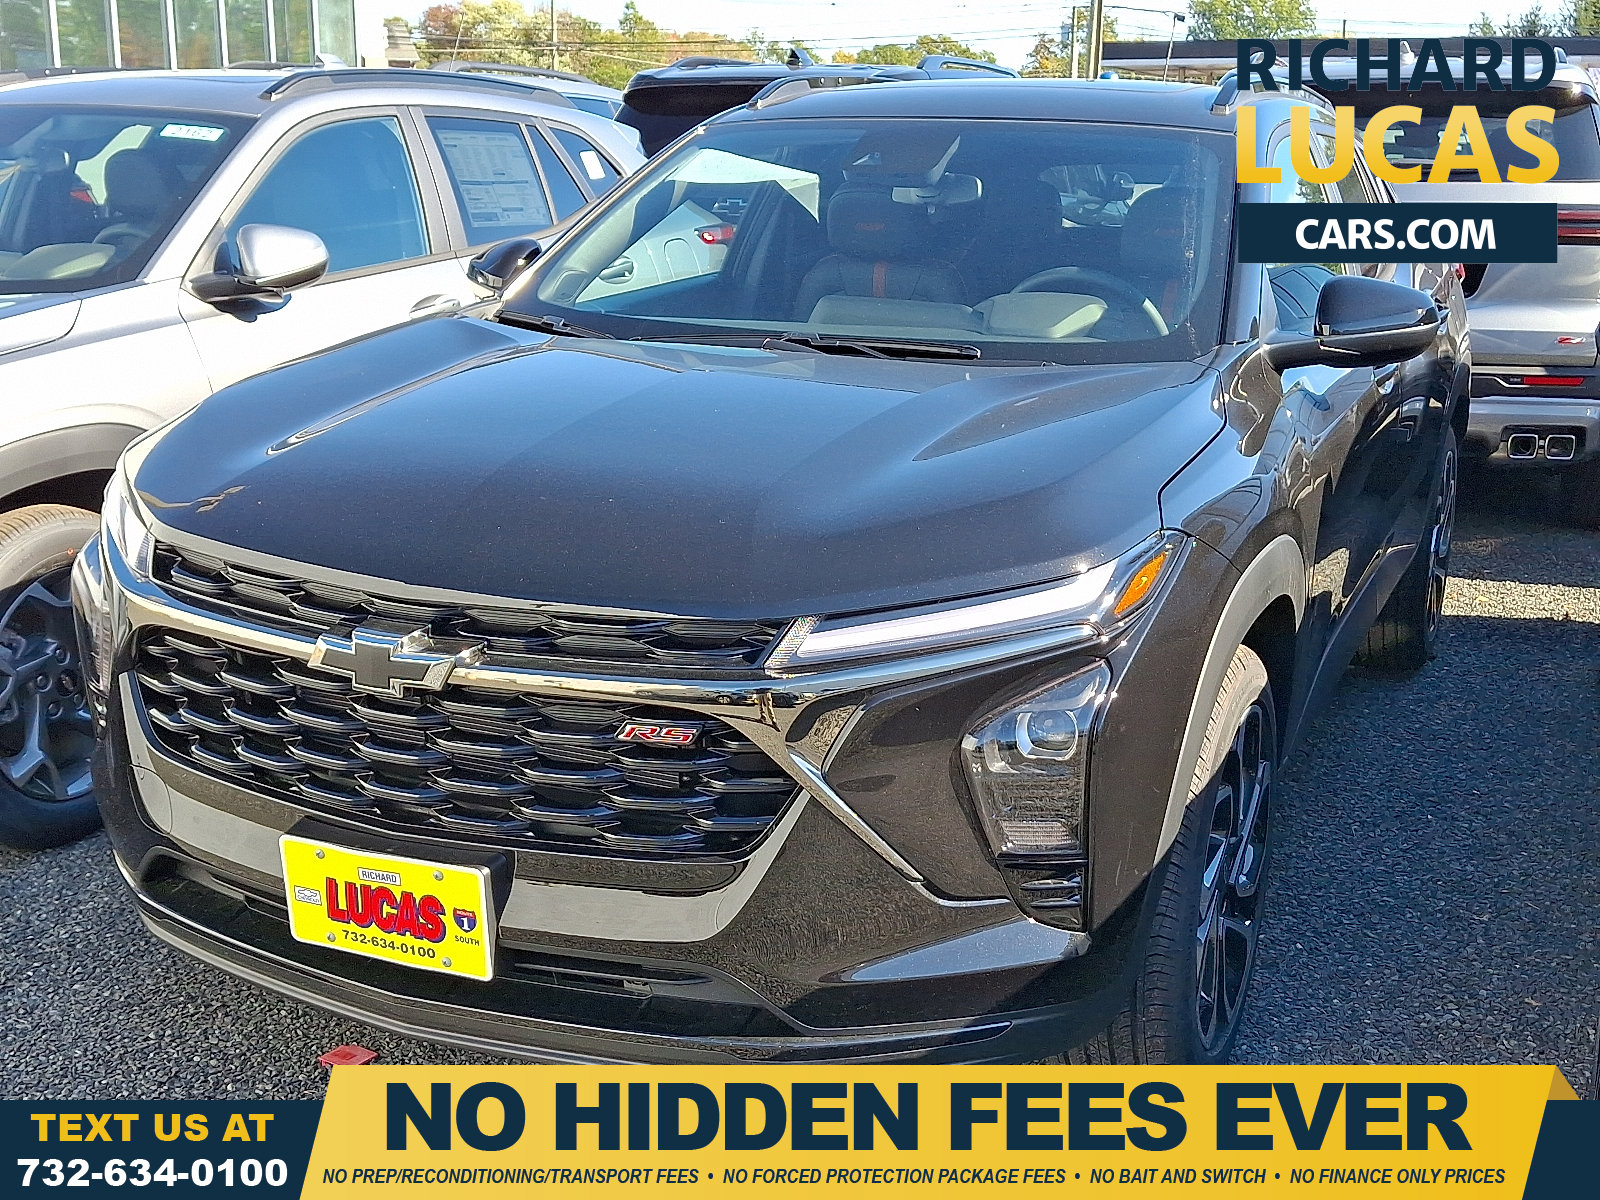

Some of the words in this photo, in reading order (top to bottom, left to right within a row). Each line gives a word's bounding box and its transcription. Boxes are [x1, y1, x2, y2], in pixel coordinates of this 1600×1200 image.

[617, 723, 698, 744] RS
[361, 870, 397, 883] RICHARD
[326, 877, 446, 943] LUCAS
[460, 917, 471, 931] 1
[342, 929, 436, 958] 732-634-0100
[454, 934, 480, 947] SOUTH
